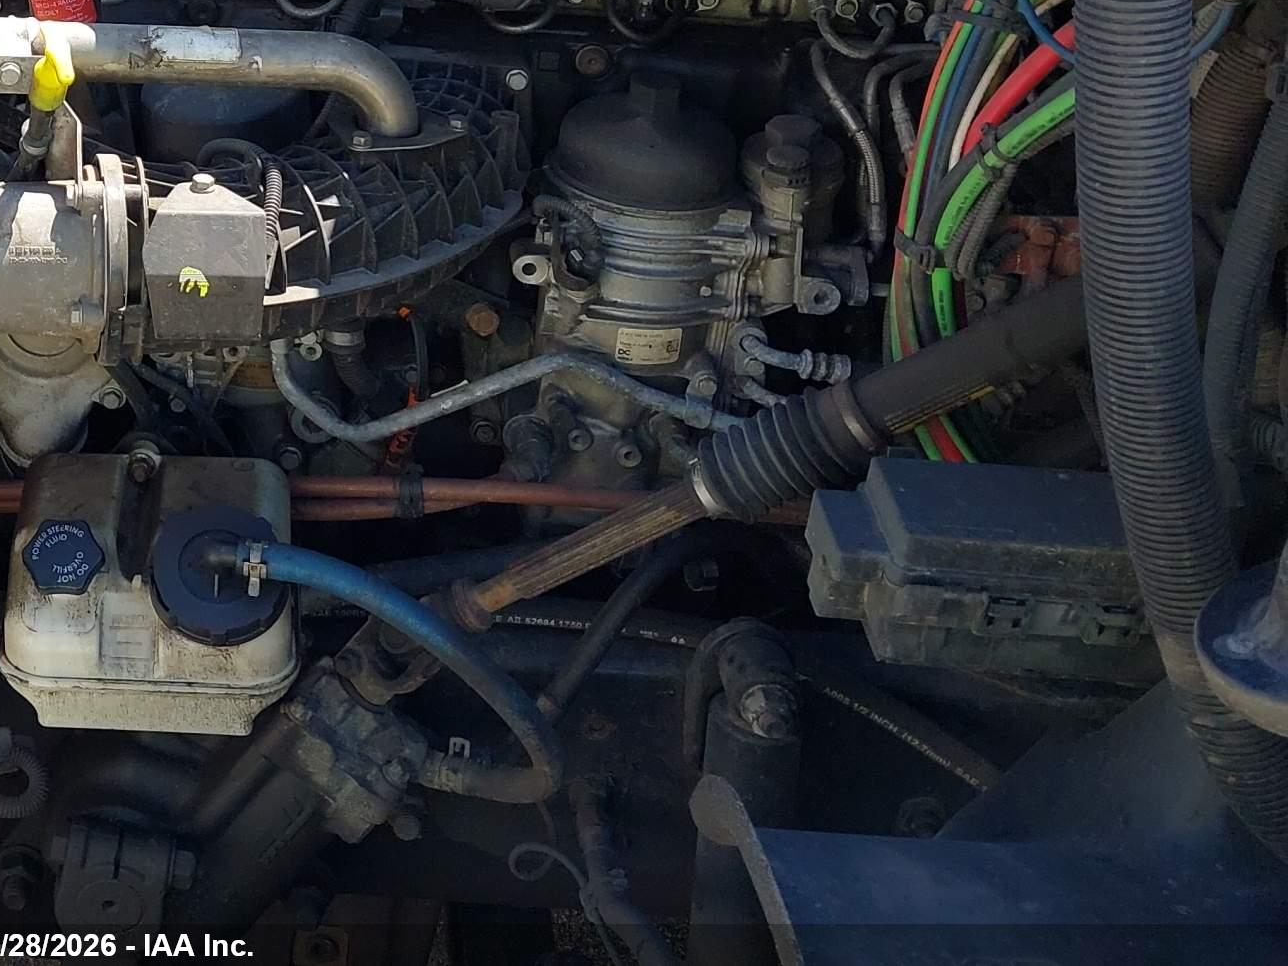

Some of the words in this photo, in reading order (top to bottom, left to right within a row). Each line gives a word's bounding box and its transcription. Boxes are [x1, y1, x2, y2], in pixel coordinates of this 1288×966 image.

[31, 532, 48, 561] POWER
[47, 524, 85, 538] STEERING
[44, 533, 68, 548] FLUID
[51, 551, 84, 574] OVERFILL
[76, 563, 89, 576] DO
[57, 574, 77, 583] NOT
[870, 712, 899, 733] INCH
